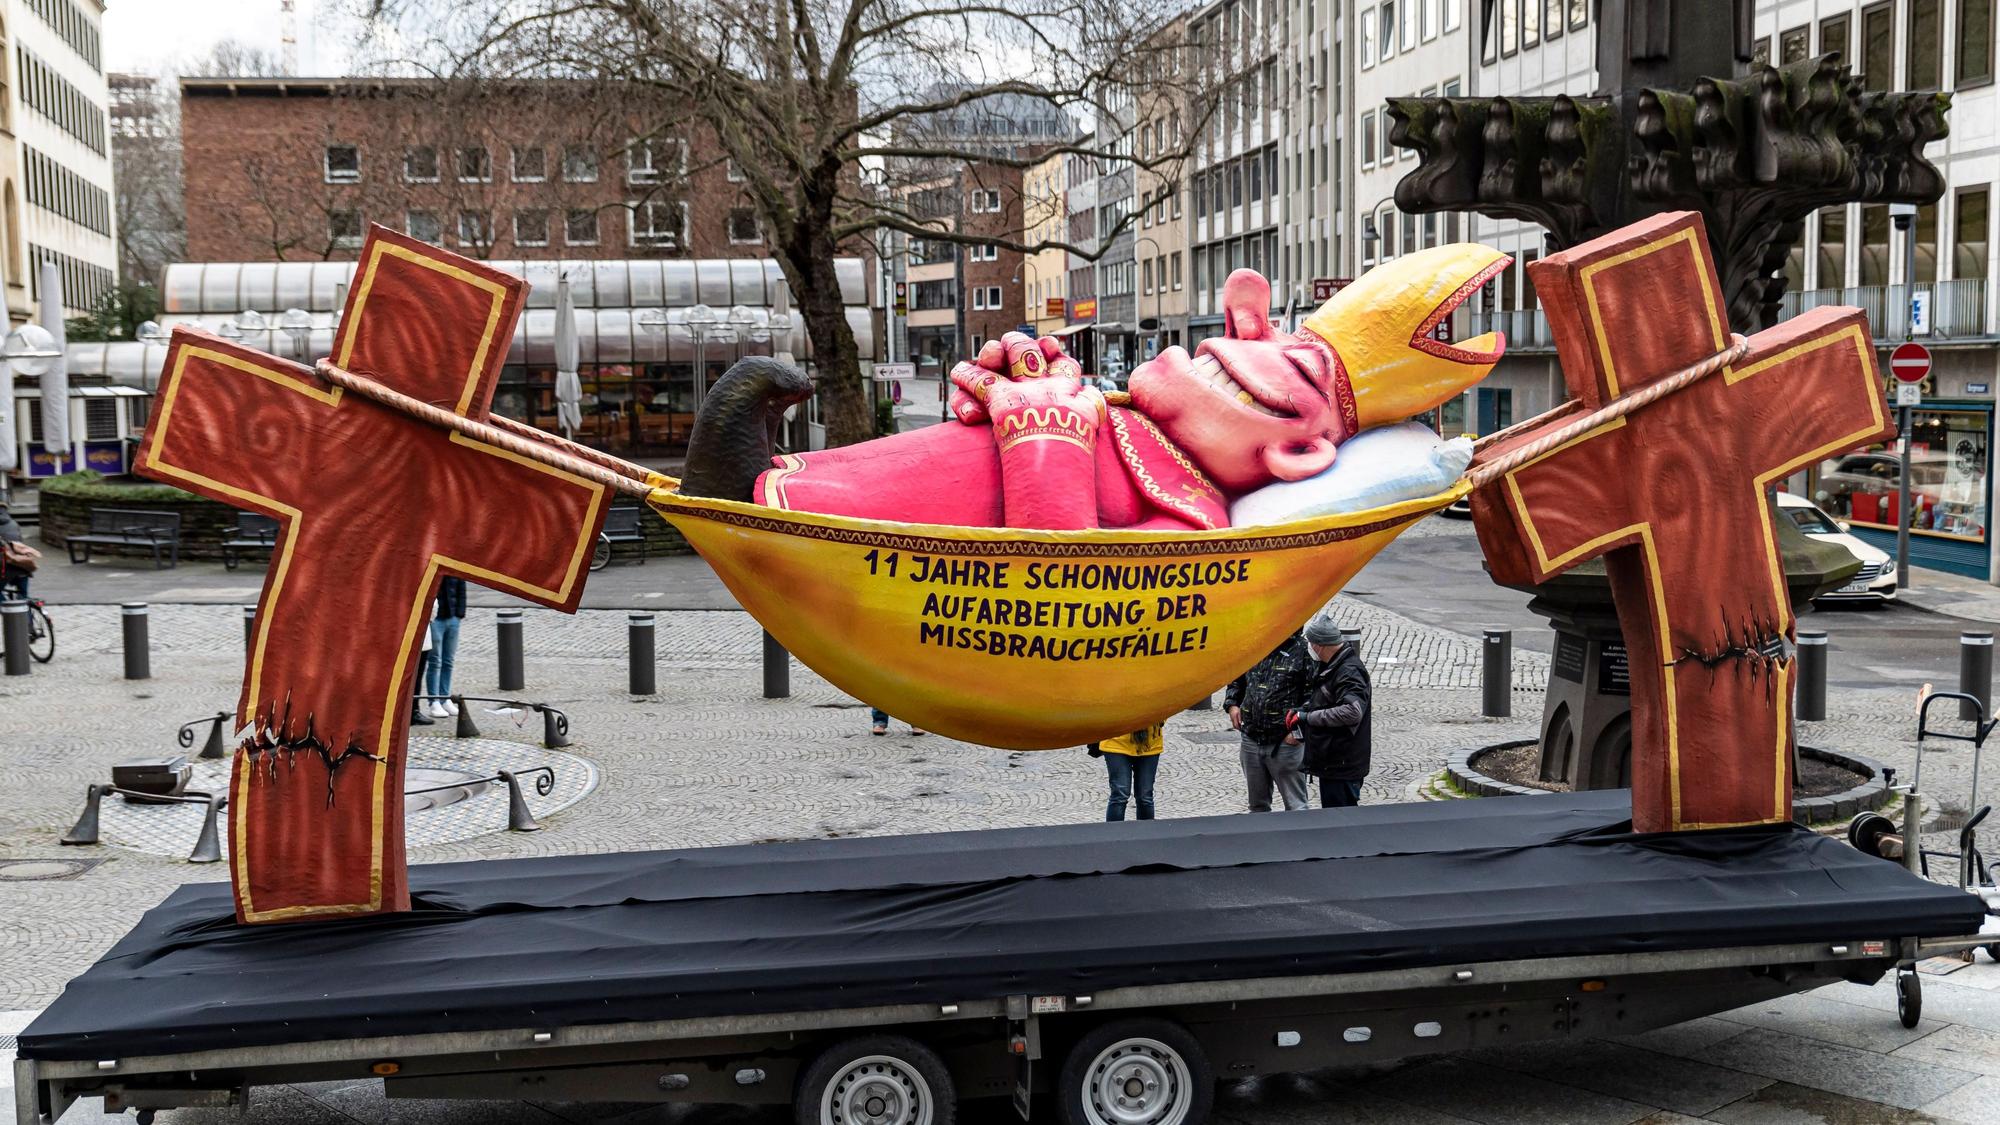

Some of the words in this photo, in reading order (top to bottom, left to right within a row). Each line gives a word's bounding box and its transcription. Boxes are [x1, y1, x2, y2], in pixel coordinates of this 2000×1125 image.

[863, 549, 899, 578] 11
[910, 556, 1011, 589] JAHRE
[1023, 558, 1252, 591] SCHONUNGSLOSE
[921, 592, 1146, 629] AUFARBEITUNG
[1156, 593, 1208, 622] DER
[920, 621, 1209, 662] MISSBRAUCHSFÄLLE!
